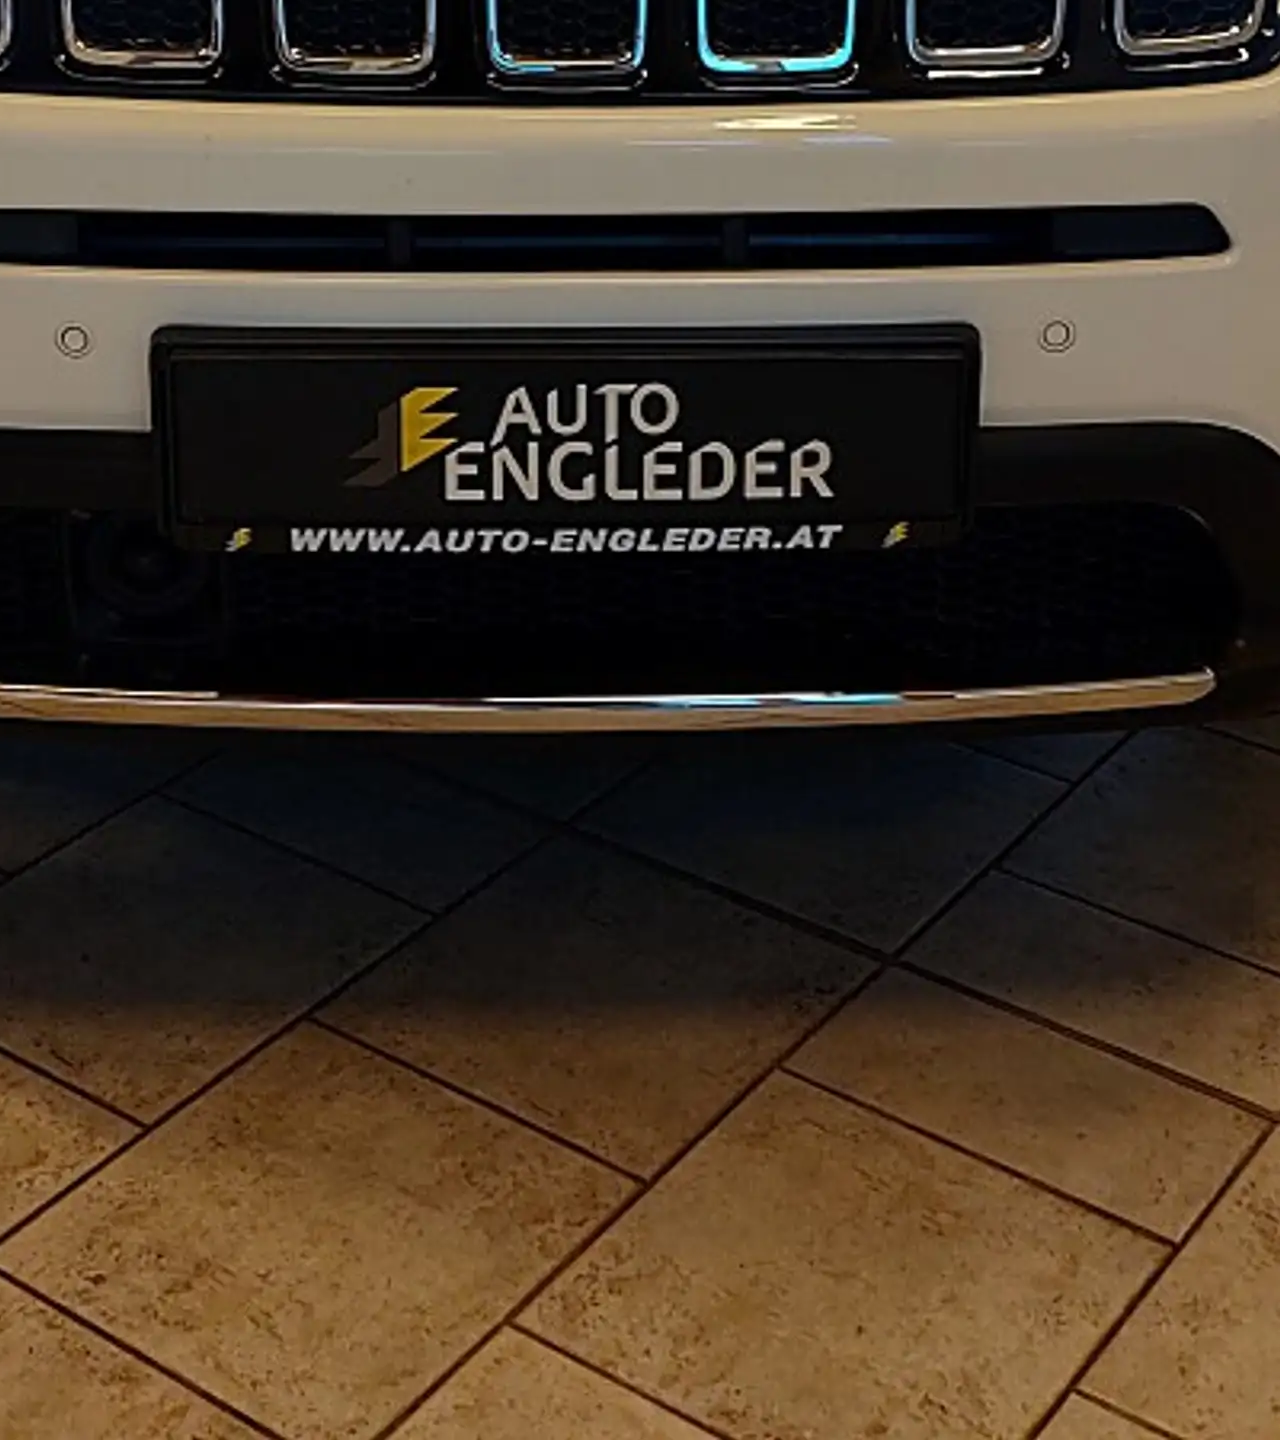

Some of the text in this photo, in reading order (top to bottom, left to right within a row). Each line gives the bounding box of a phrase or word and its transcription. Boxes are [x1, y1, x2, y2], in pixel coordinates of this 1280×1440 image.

[489, 382, 680, 447] AUTO
[444, 439, 835, 501] ENGLEDER
[291, 524, 843, 553] WWW.AUTO-ENGLEDER.AT
